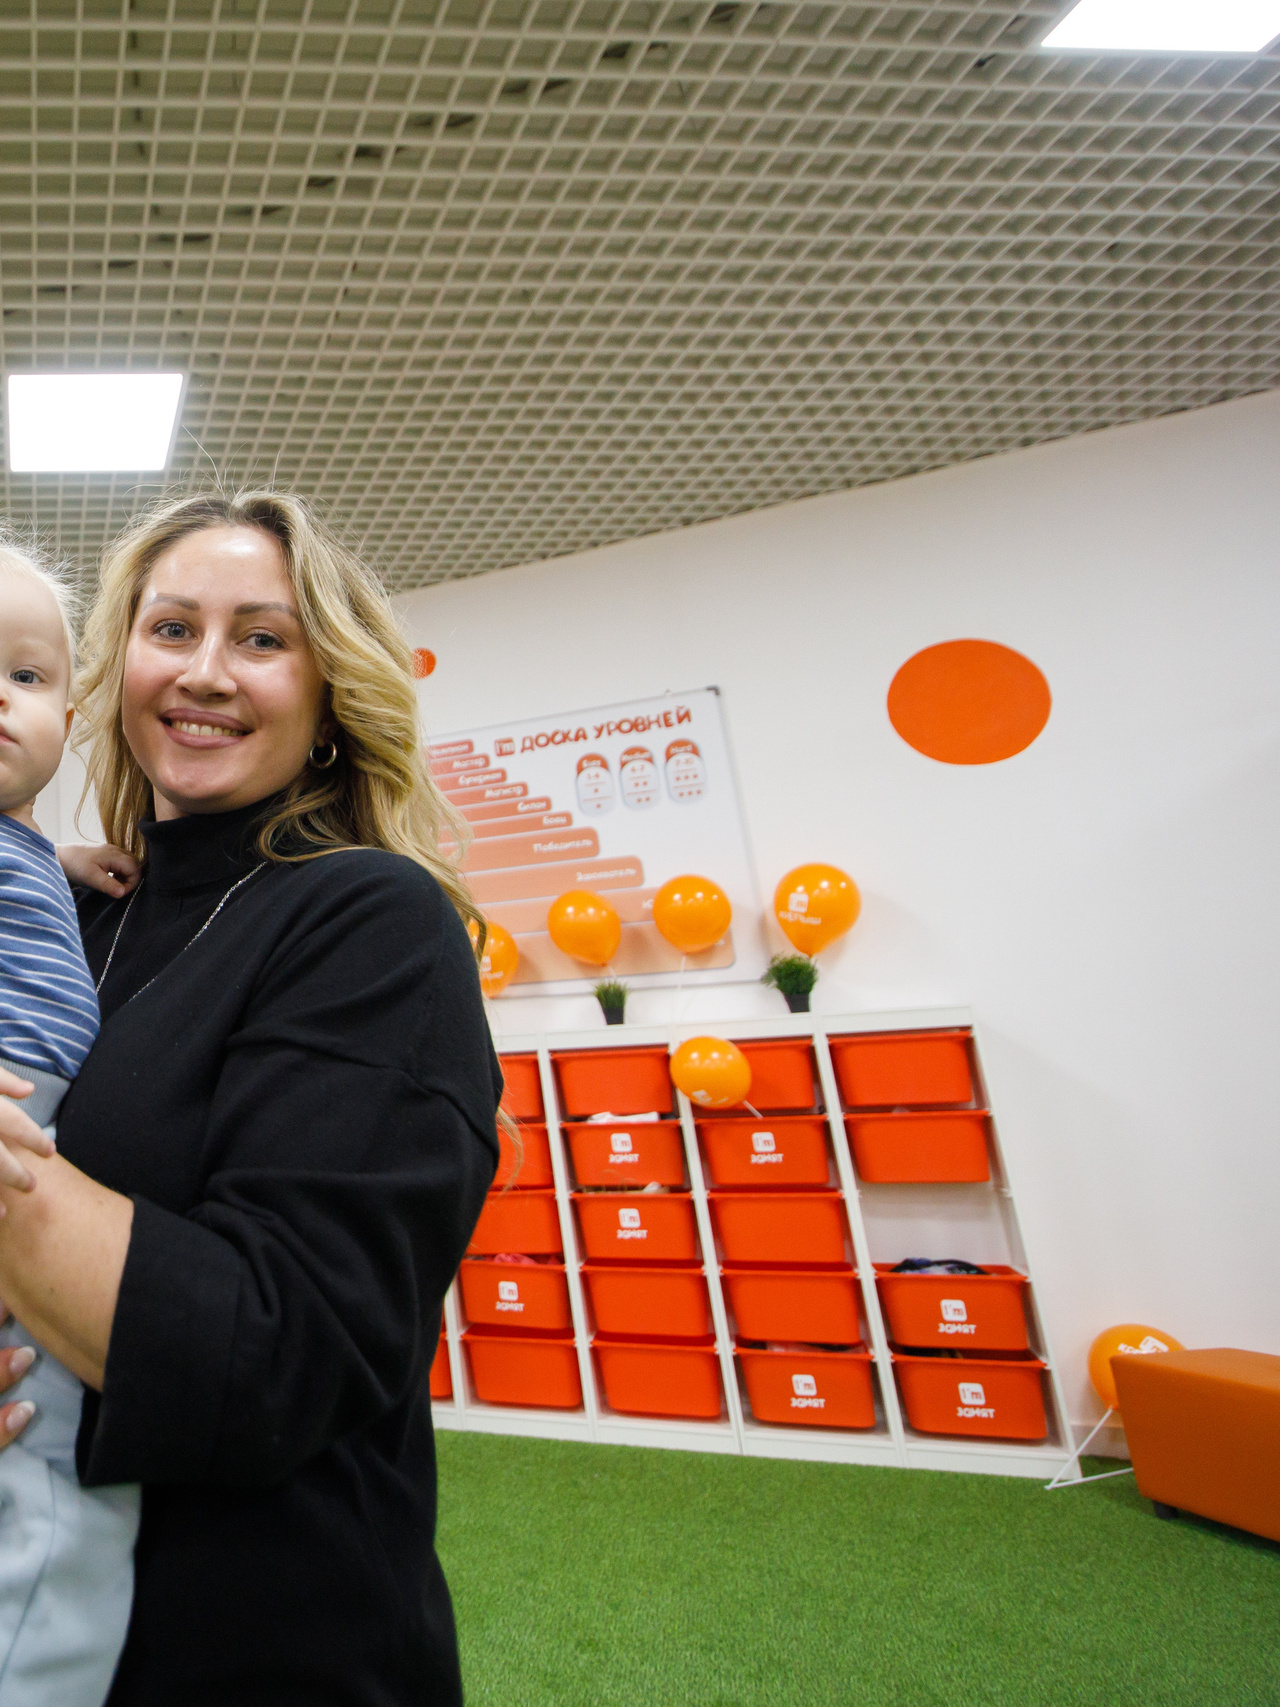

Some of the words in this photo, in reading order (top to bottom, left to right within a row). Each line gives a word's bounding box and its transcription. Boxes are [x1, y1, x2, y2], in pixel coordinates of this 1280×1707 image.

[521, 727, 588, 753] ДОСКА
[593, 705, 692, 739] УРОВНЕЙ
[532, 838, 594, 853] Победитель
